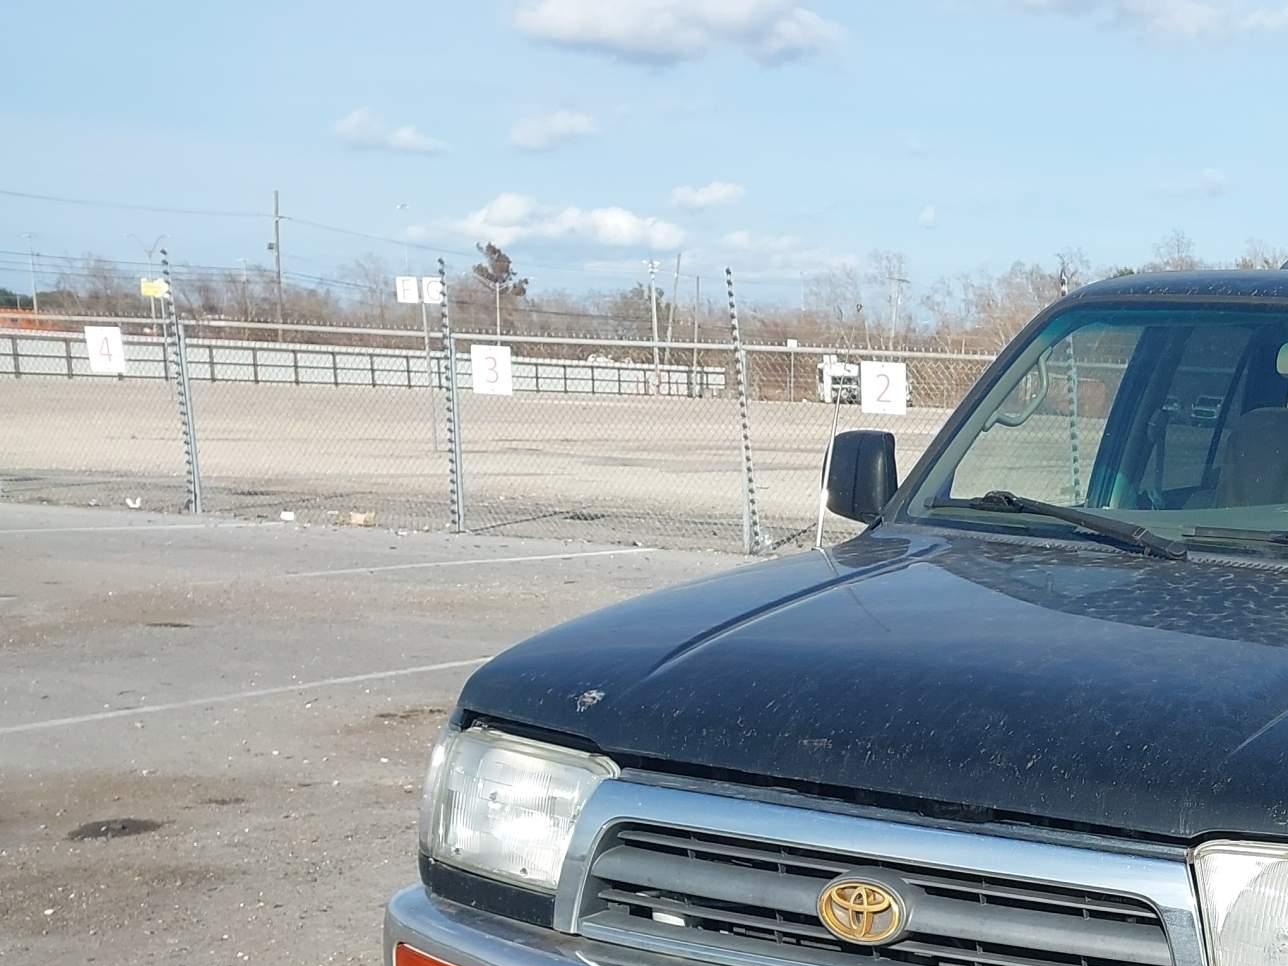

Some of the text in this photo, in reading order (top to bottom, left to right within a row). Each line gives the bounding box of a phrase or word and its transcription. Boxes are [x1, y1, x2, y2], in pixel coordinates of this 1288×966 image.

[98, 335, 112, 362] 4
[484, 356, 499, 384] 3
[876, 373, 892, 403] 2
